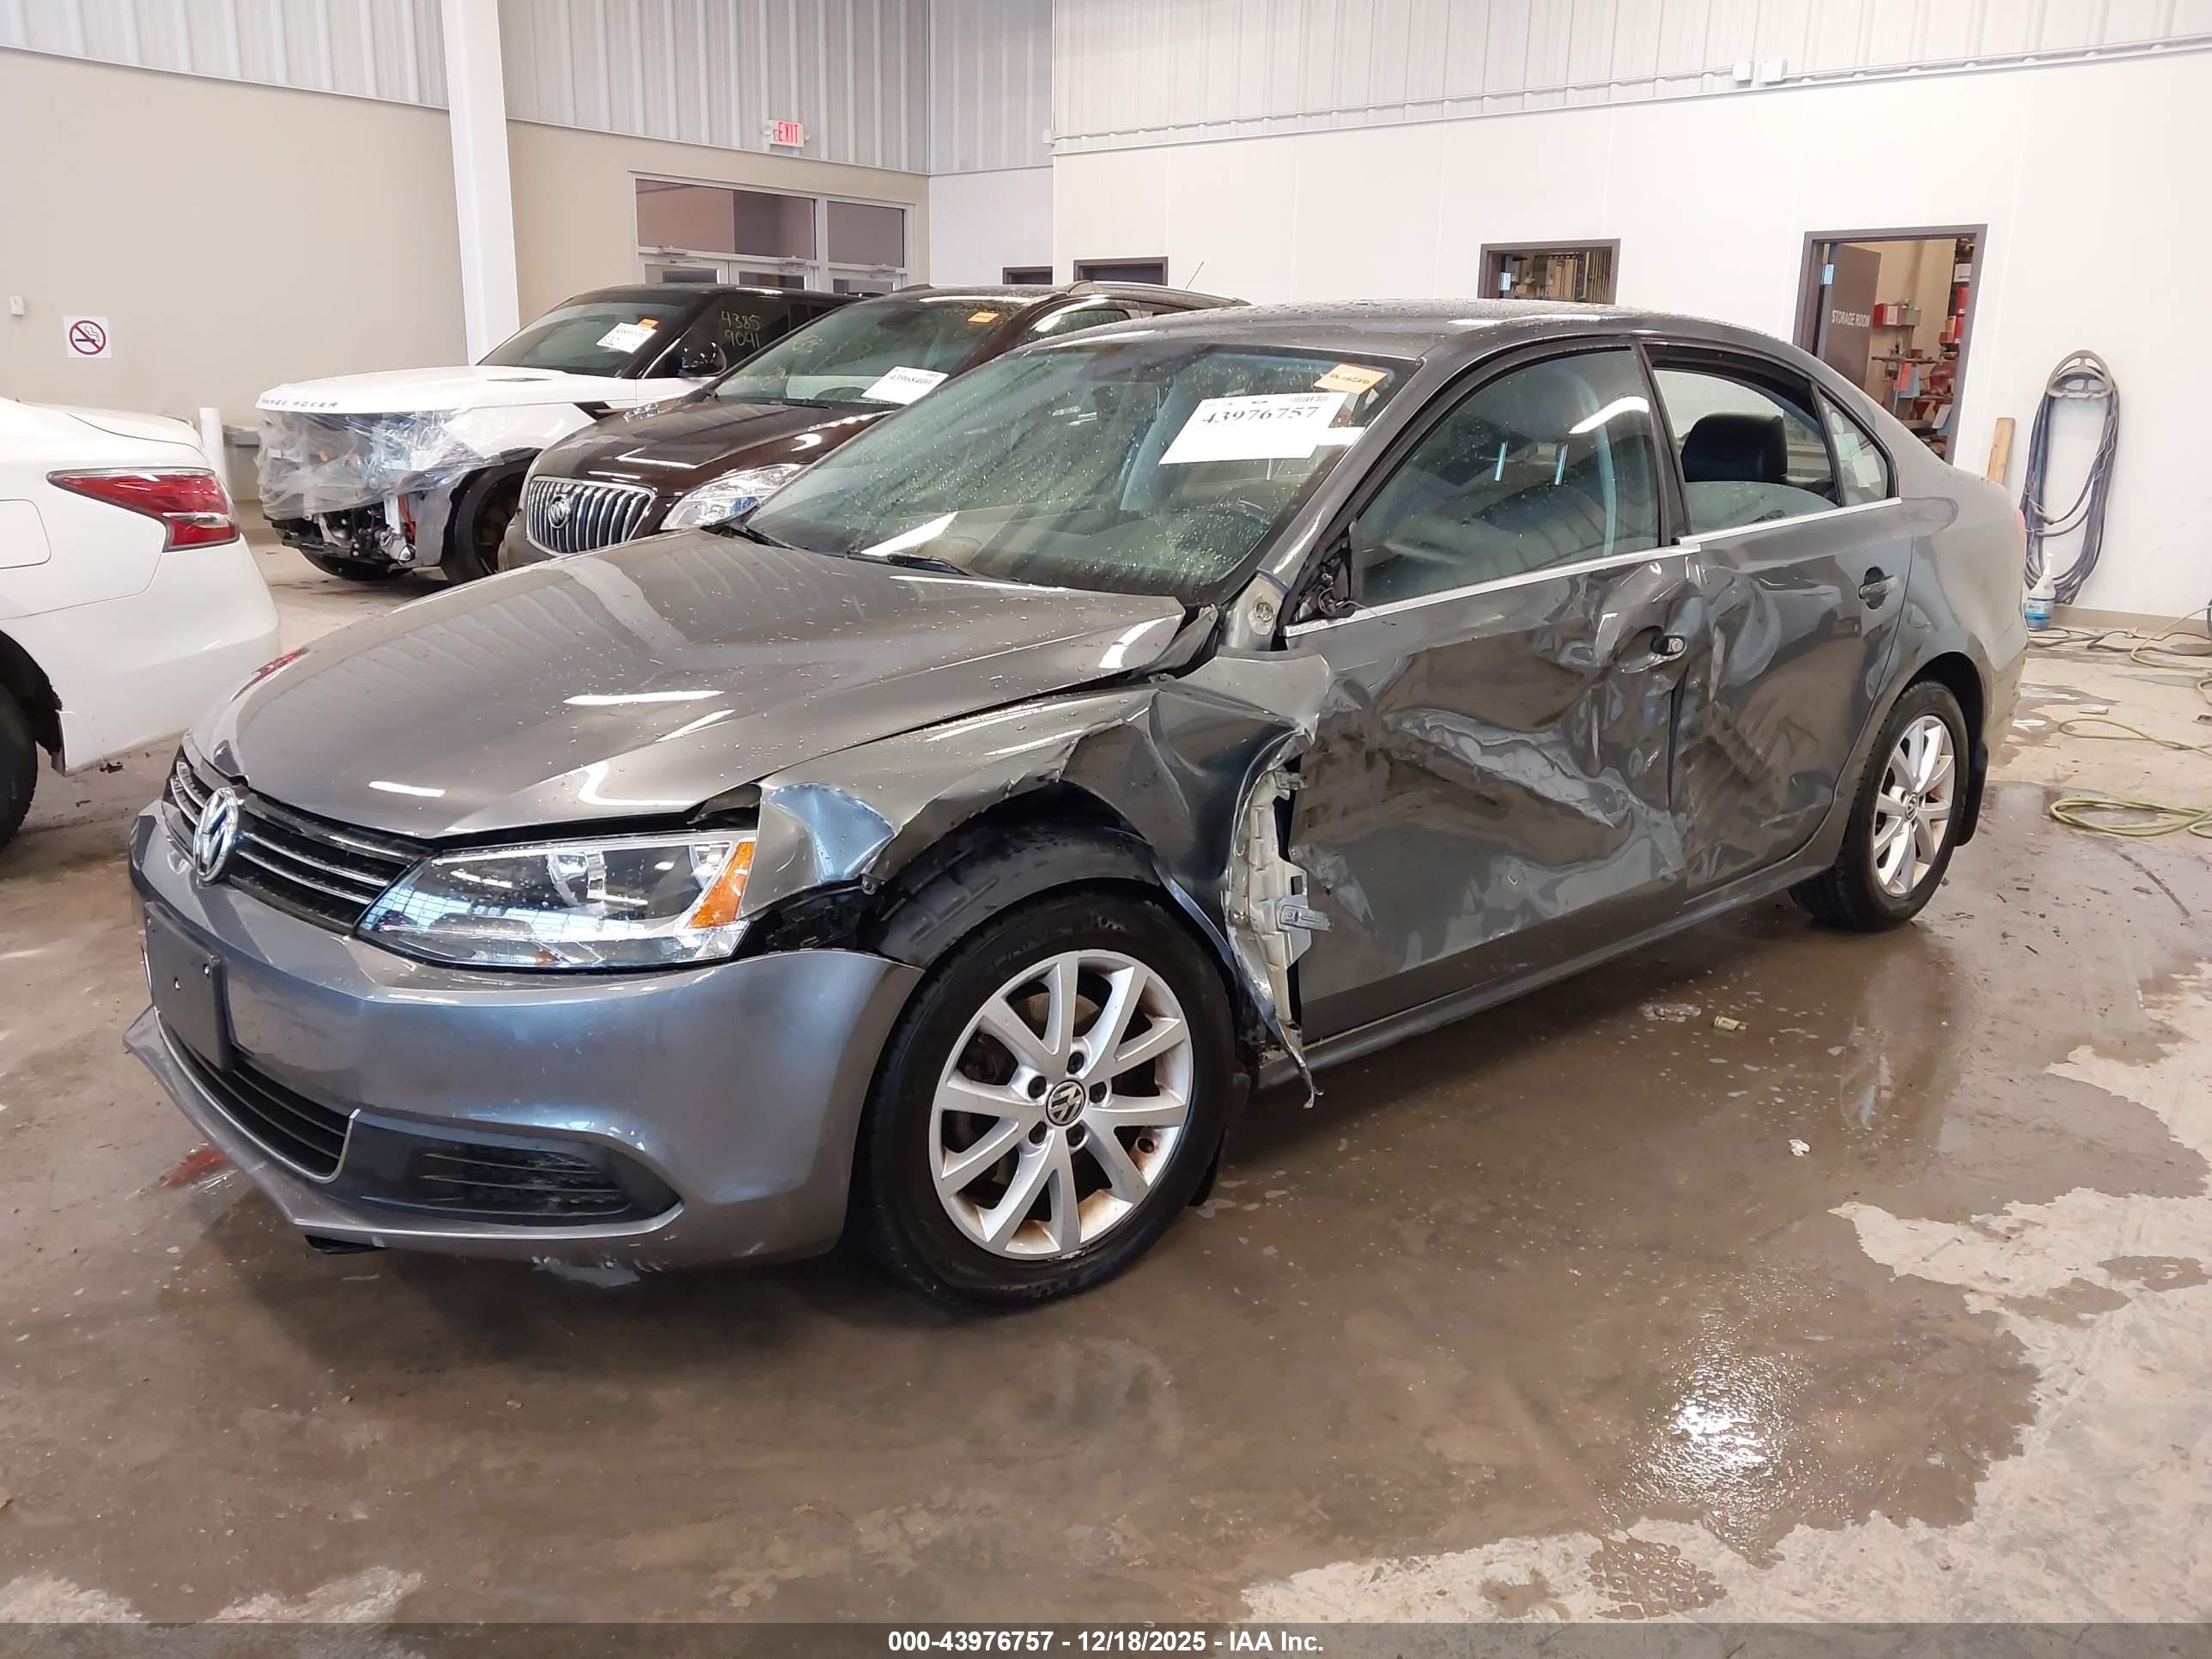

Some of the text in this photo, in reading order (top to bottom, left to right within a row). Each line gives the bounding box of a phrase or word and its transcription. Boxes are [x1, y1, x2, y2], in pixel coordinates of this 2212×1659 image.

[778, 121, 799, 143] EXIT
[721, 310, 761, 331] 4385
[1832, 310, 1870, 327] STORAGE ROOM
[725, 329, 760, 349] 9041
[1201, 405, 1320, 424] 43976757
